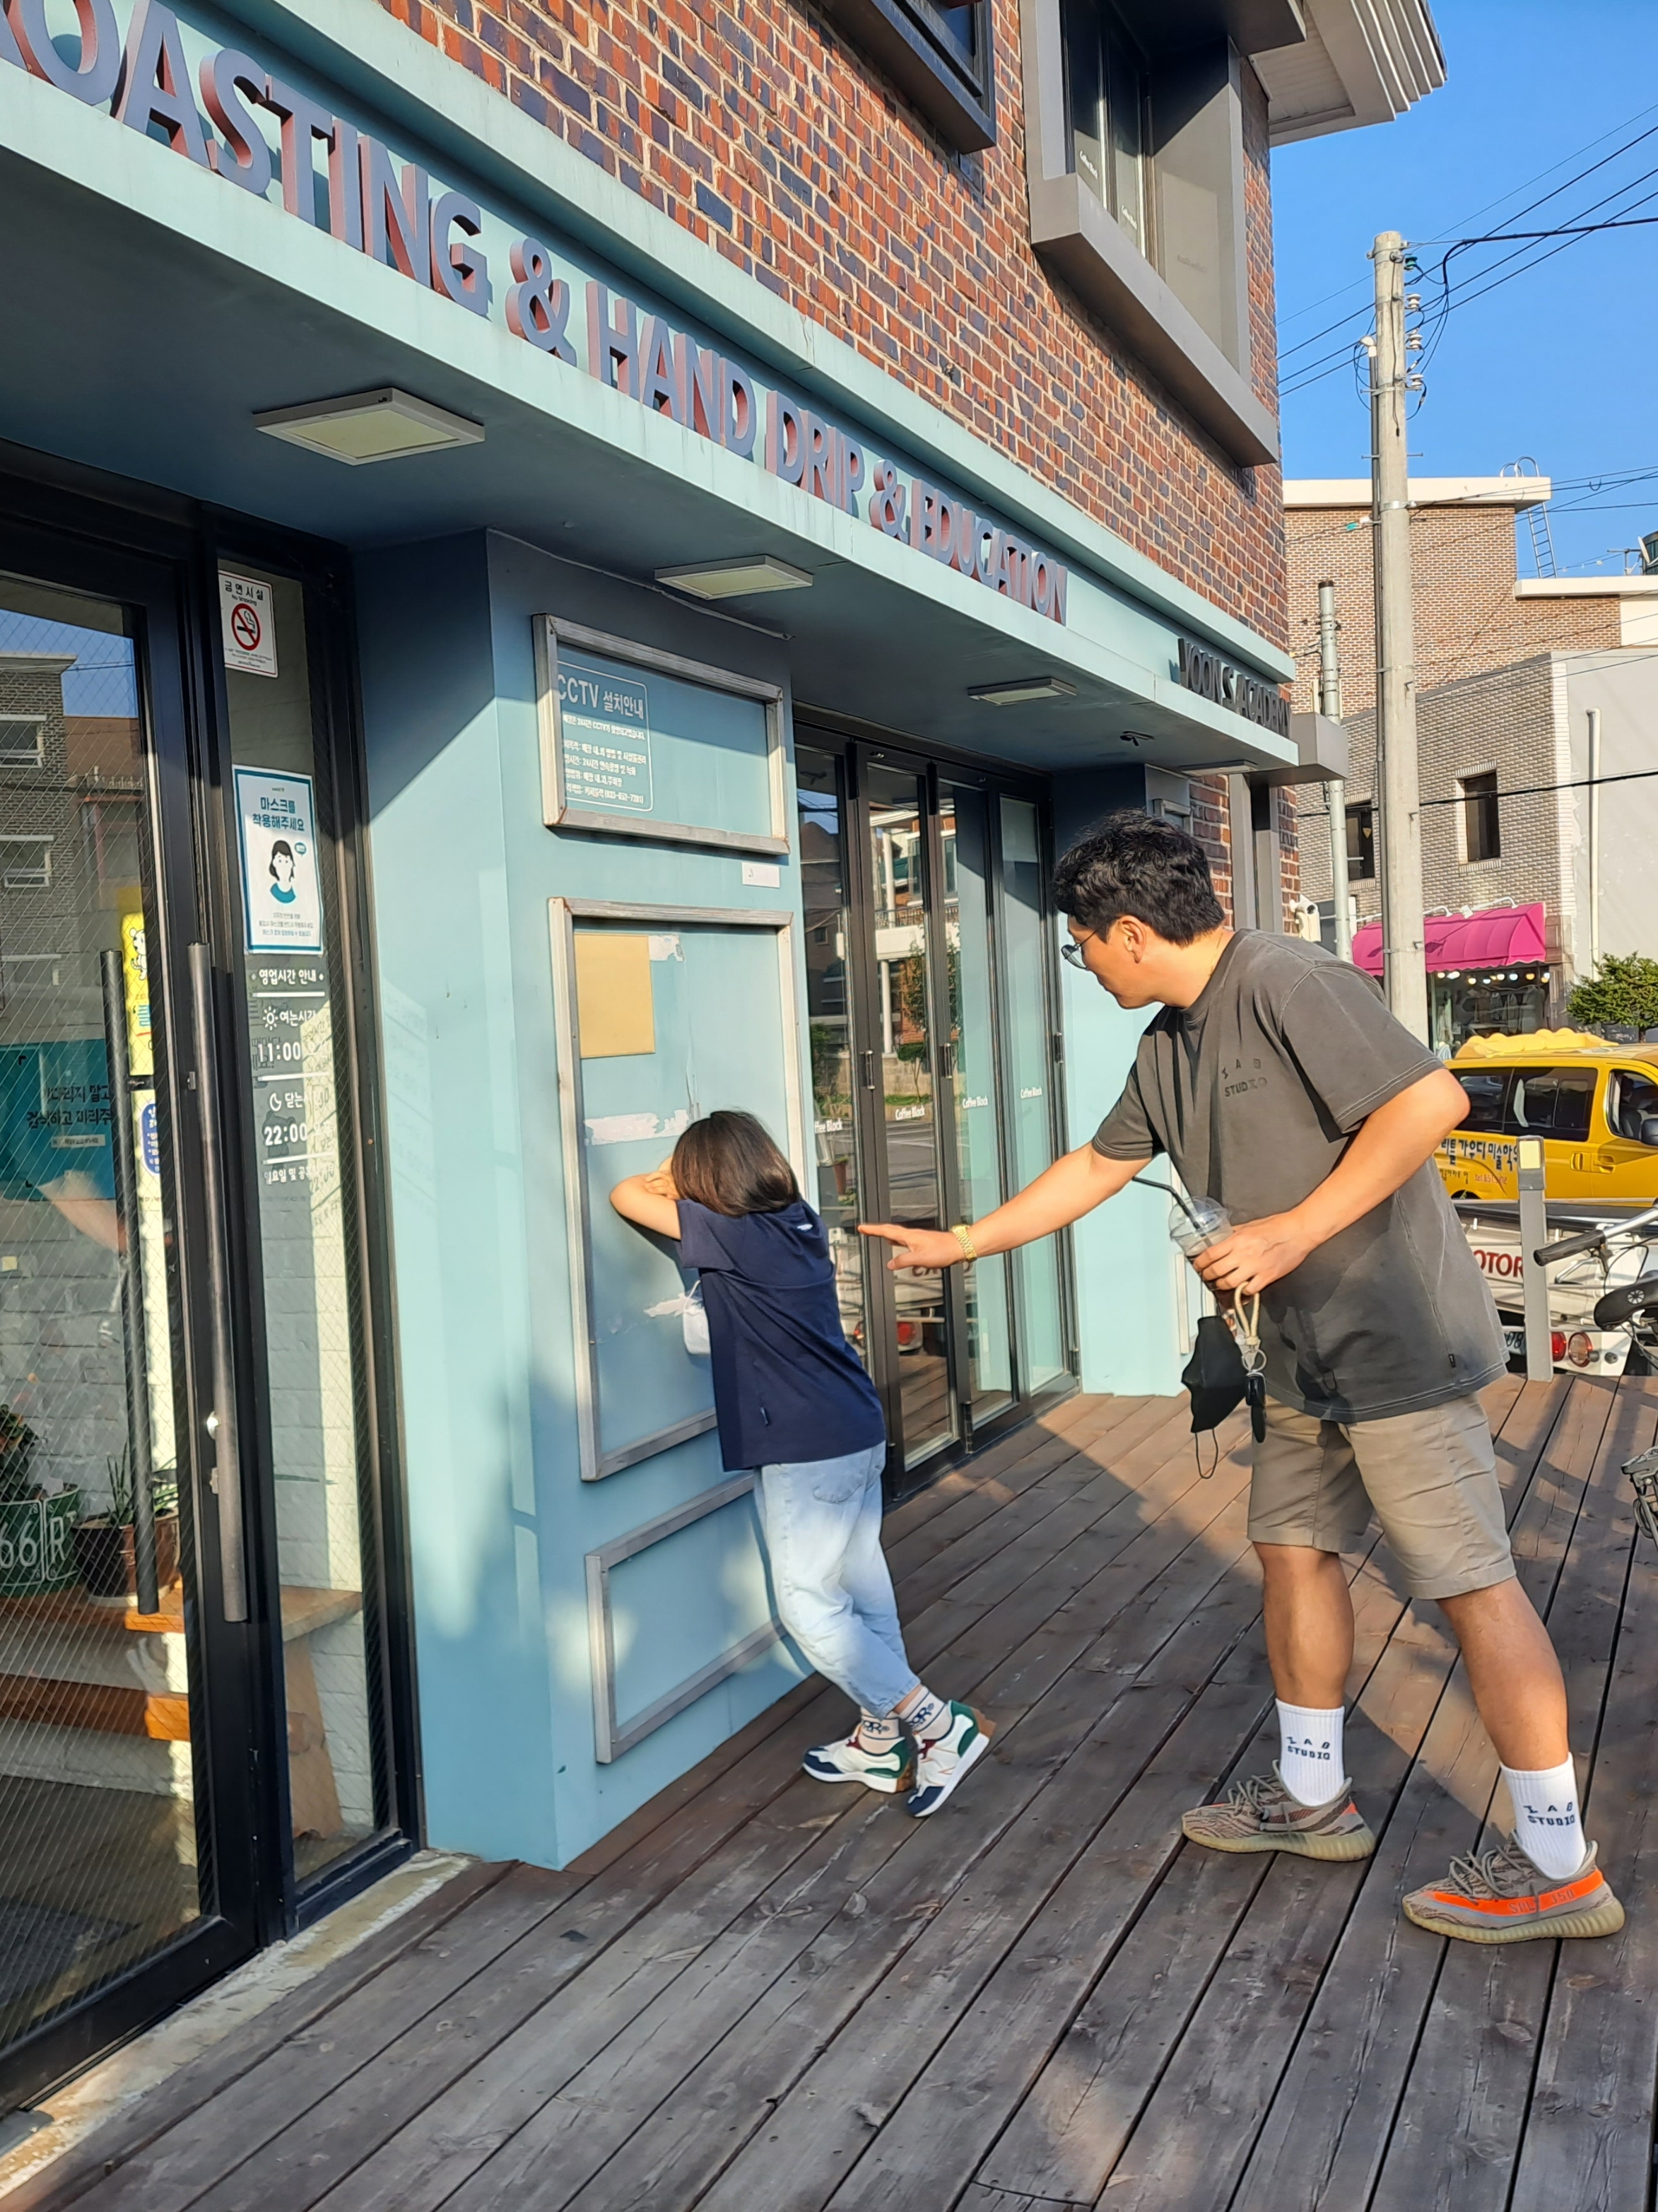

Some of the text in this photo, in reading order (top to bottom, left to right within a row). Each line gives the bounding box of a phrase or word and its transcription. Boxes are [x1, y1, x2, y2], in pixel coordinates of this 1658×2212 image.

[0, 0, 1068, 626] OASTING & HAND DRIP & EDUCATION
[558, 674, 644, 720] CCTV 설치안내
[260, 797, 295, 814] 마스크를
[252, 813, 305, 832] 착용해주세요
[259, 969, 317, 985] 영업시간 안내
[257, 1041, 301, 1063] 11:00
[1224, 1077, 1268, 1097] STUDIO
[895, 1106, 912, 1121] Coffee
[264, 1123, 308, 1146] 22:00
[1288, 1745, 1331, 1761] STUDIO
[1527, 1814, 1575, 1826] STUDIO
